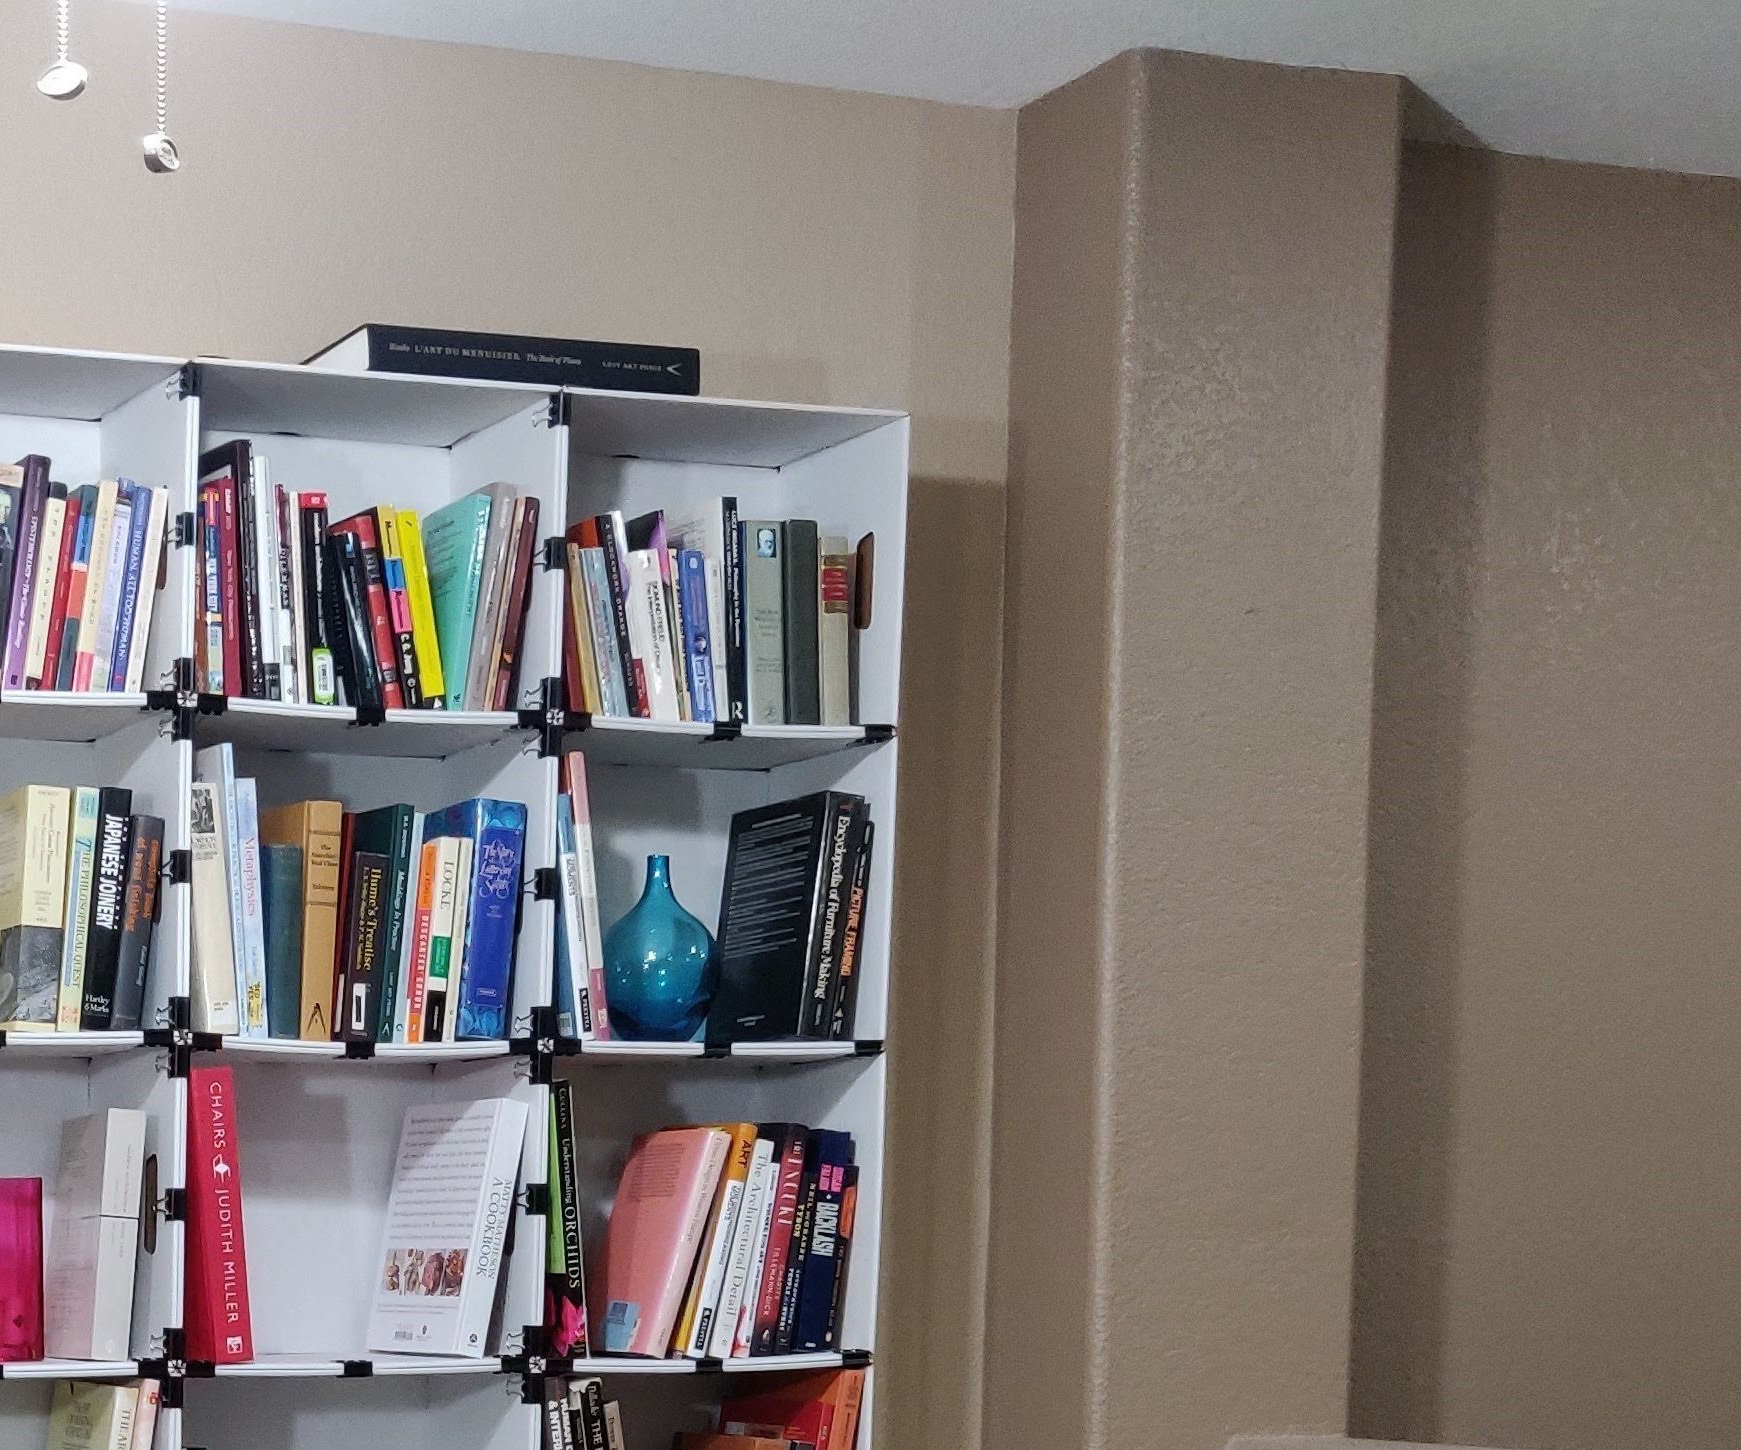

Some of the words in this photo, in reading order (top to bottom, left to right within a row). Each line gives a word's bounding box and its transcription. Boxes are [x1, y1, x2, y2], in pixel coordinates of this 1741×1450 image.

[99, 813, 126, 876] JAPANESE
[826, 815, 851, 888] Encyclopedia
[241, 837, 258, 915] Metaphysics
[366, 867, 382, 915] Hume's
[439, 861, 453, 909] LOCKE
[827, 889, 841, 901] of
[74, 869, 88, 955] PHILOSOPHICAL
[94, 876, 120, 929] JOINERY
[820, 901, 838, 953] Furniture
[361, 917, 377, 971] Treatise
[71, 957, 82, 988] QUEST
[813, 954, 832, 999] Making
[208, 1081, 226, 1149] CHAIRS
[560, 1137, 574, 1203] Understanding
[736, 1139, 752, 1168] ART
[753, 1152, 767, 1176] The
[491, 1177, 503, 1188] A
[497, 1179, 512, 1216] MATTY
[806, 1182, 815, 1208] NEIL
[214, 1188, 234, 1253] JUDITH
[475, 1191, 501, 1278] COOKBOOK
[734, 1181, 762, 1270] Architectural
[792, 1203, 804, 1237] TYSON
[808, 1201, 840, 1257] BACKLASH
[486, 1218, 505, 1279] MATHESON
[563, 1205, 580, 1288] ORCHIDS
[221, 1261, 240, 1323] MILLER
[724, 1274, 743, 1316] Detail
[547, 1399, 558, 1410] &
[590, 1419, 603, 1445] THE
